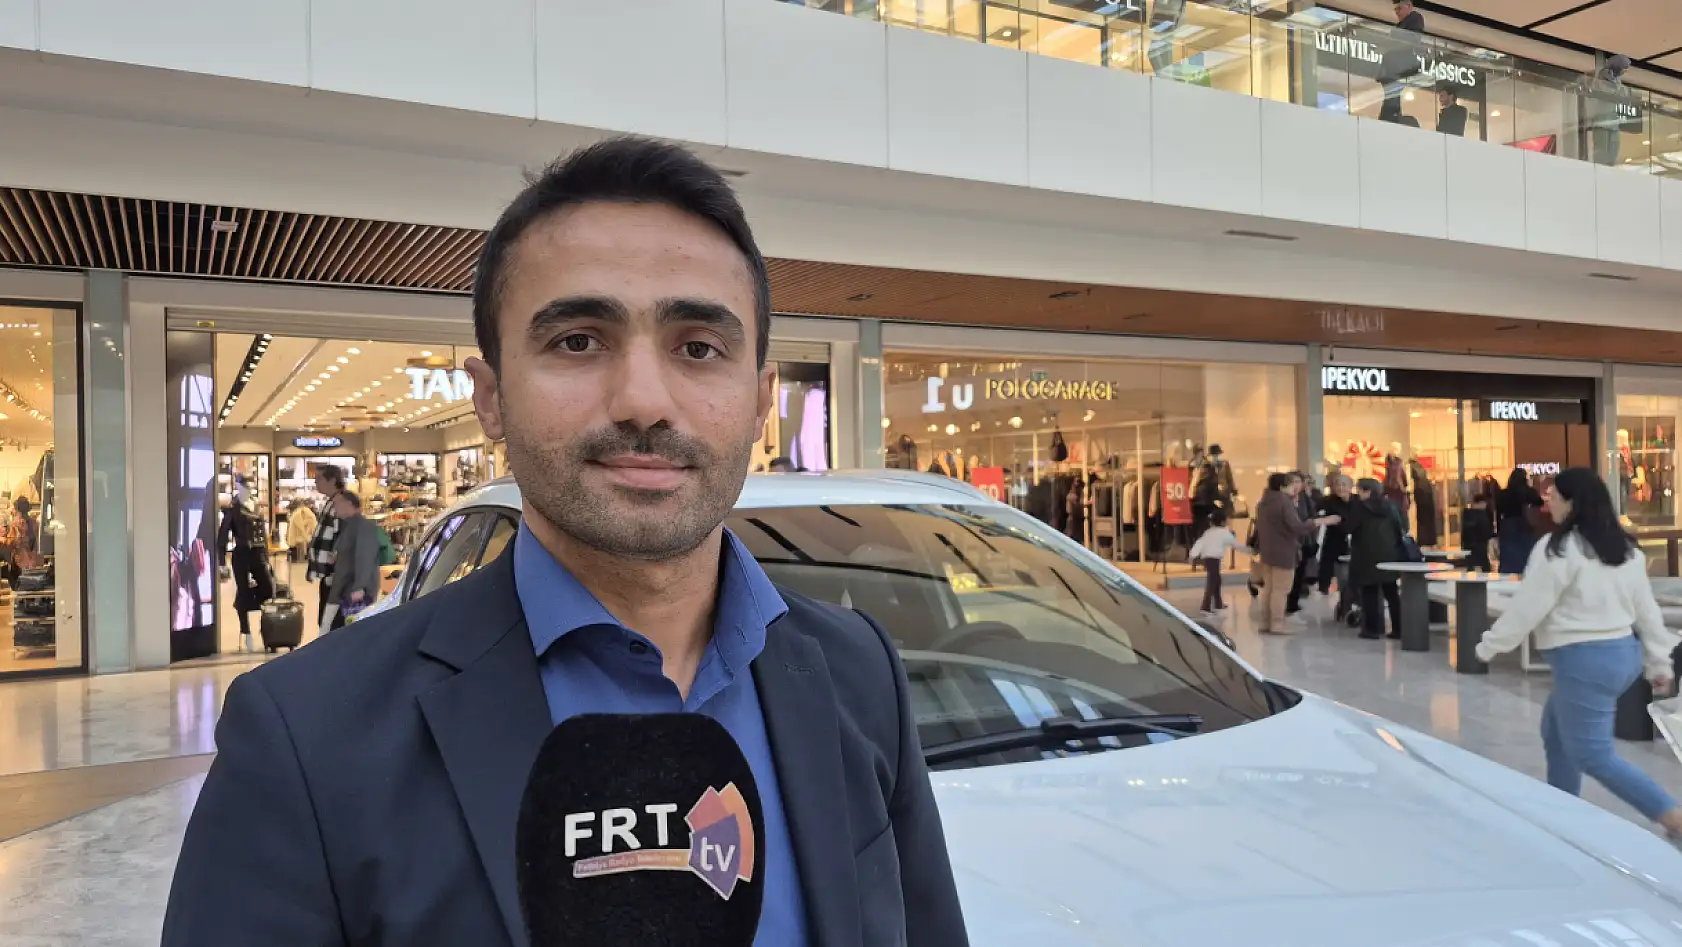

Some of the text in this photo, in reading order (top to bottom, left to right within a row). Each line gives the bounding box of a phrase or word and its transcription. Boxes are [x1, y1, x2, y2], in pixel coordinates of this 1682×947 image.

[984, 376, 1119, 402] POLOGARAGE
[1321, 366, 1390, 392] IPEKYOL
[1490, 401, 1539, 420] IPEKYOL
[564, 802, 678, 857] FRT
[699, 836, 736, 872] tv
